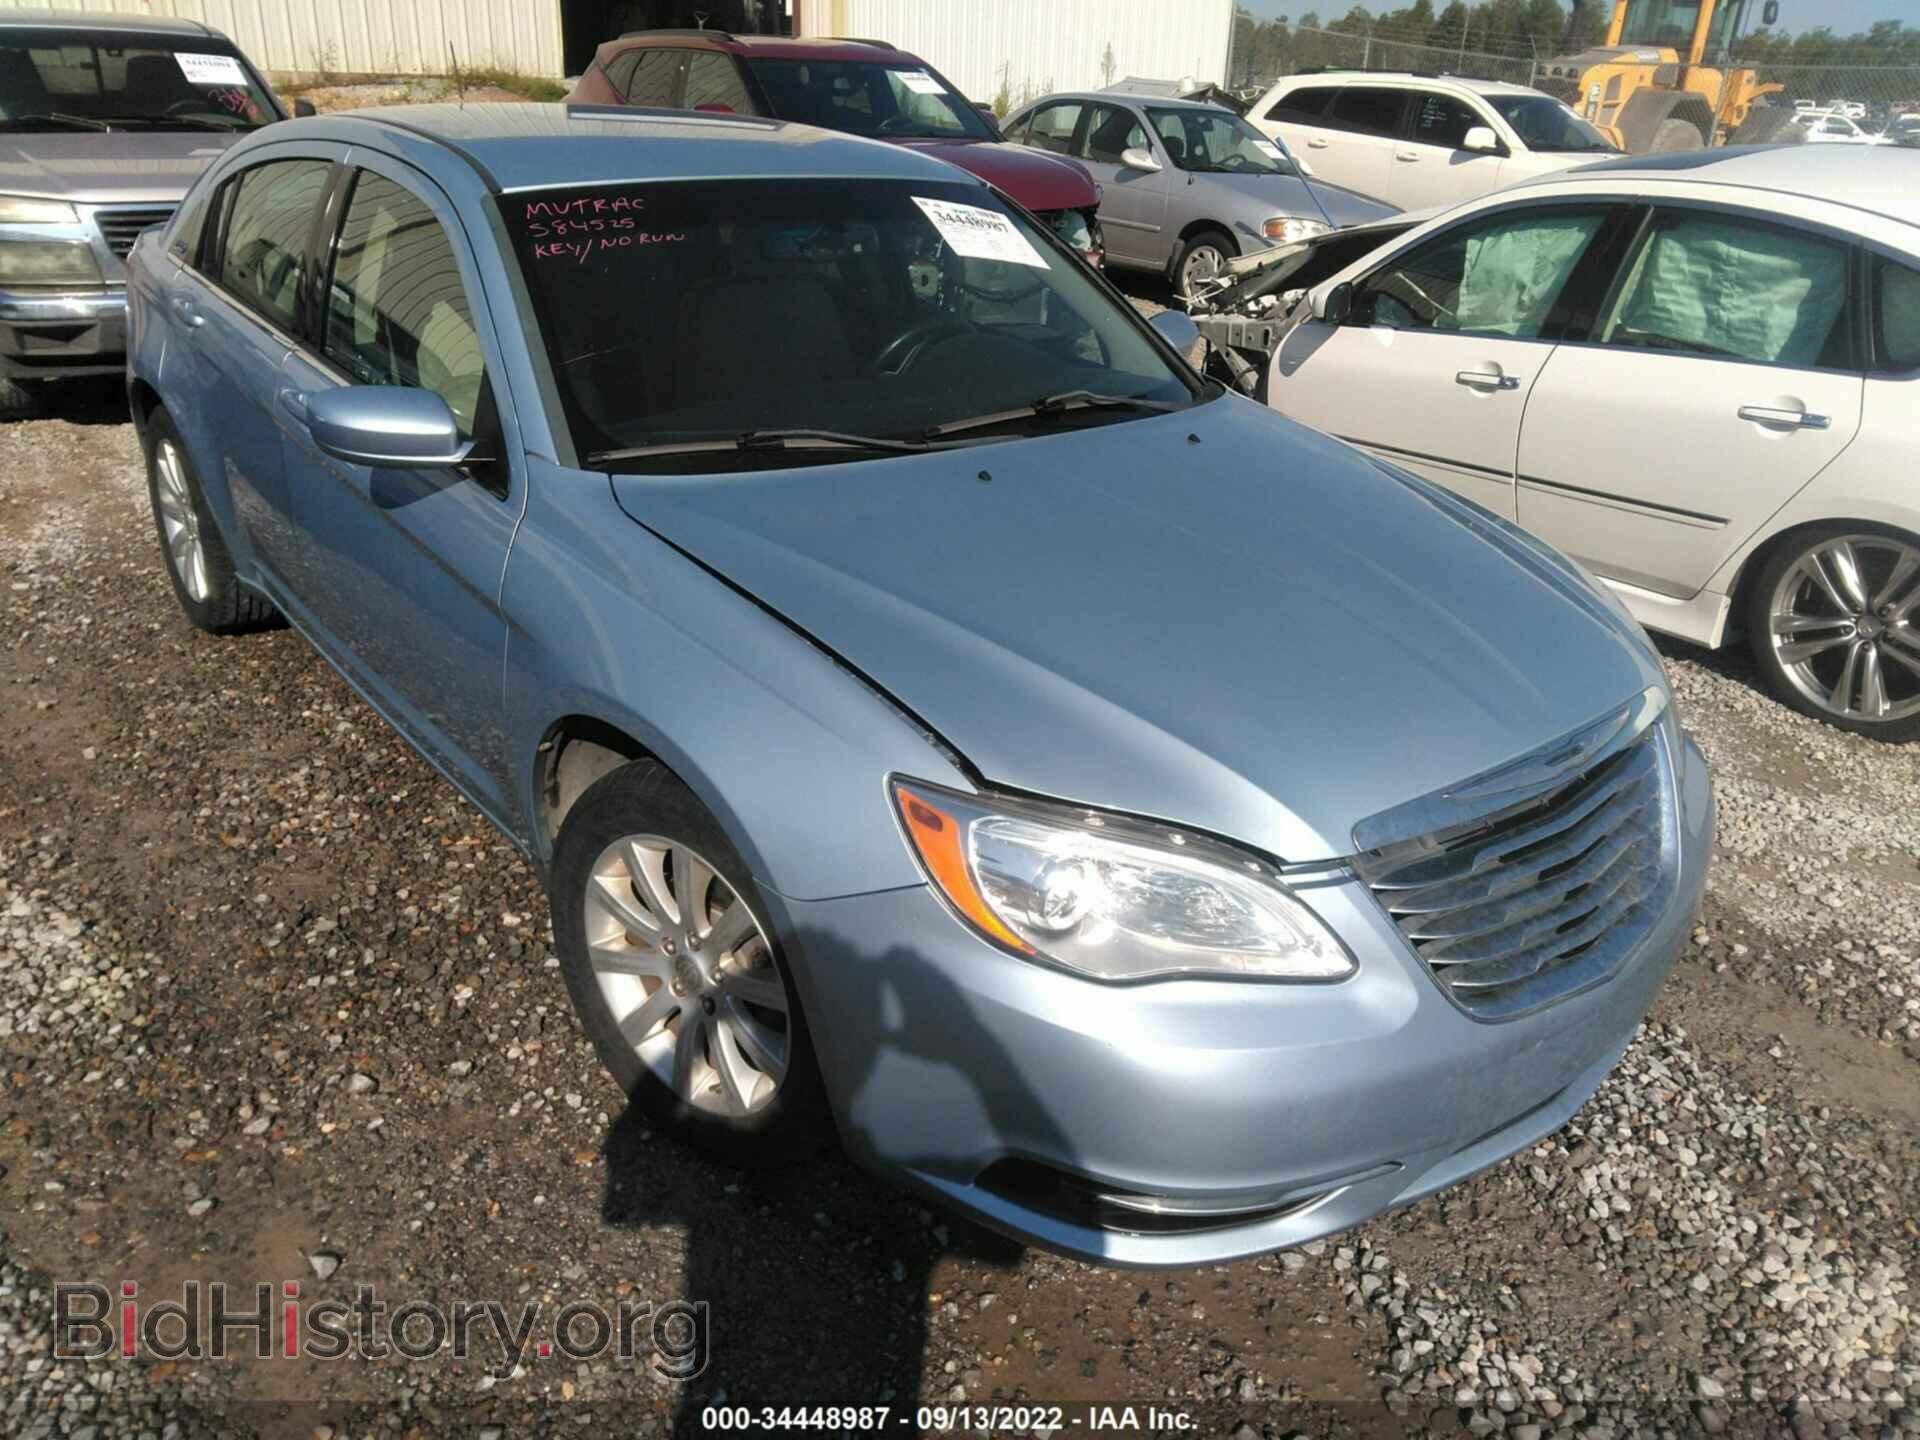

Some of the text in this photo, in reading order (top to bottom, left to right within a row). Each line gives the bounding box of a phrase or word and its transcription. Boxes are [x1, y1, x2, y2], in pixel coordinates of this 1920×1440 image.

[534, 232, 686, 265] KEY/ NO RUN
